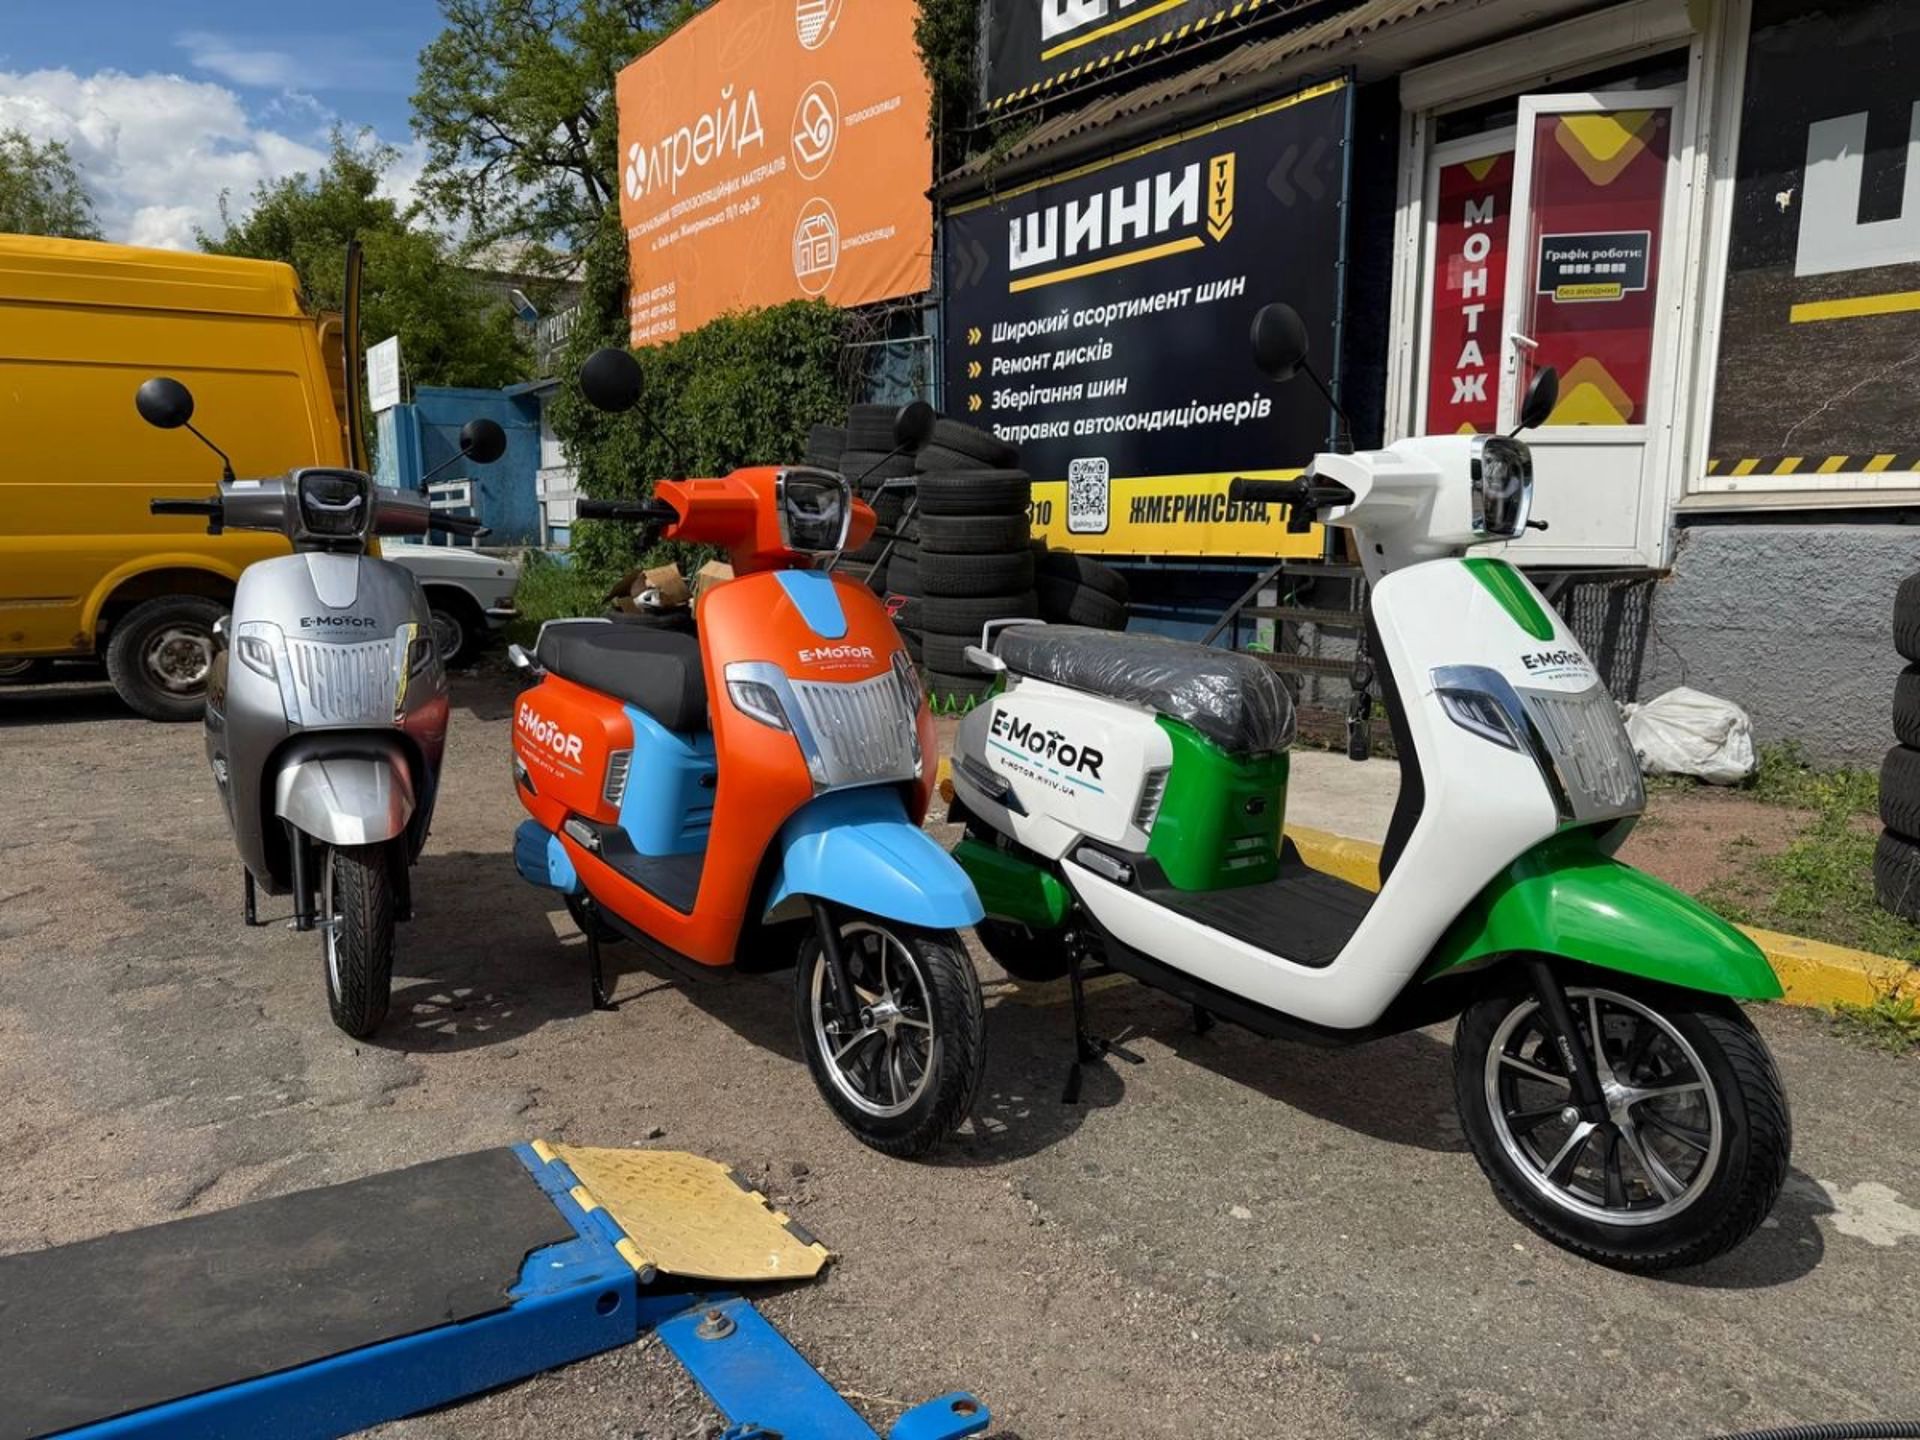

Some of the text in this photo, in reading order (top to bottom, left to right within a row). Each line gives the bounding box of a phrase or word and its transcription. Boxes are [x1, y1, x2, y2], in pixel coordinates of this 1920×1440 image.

[1215, 160, 1228, 217] ТУТ
[1009, 163, 1201, 271] ШИНИ
[1545, 247, 1642, 262] Графік роботи:
[991, 275, 1246, 343] Широкий асортимент шин
[1450, 195, 1494, 404] МОНТАЖ
[991, 339, 1113, 377] Ремонт дисків
[991, 376, 1128, 414] Зберігання шин
[993, 393, 1272, 444] Заправка автокондиціонерів
